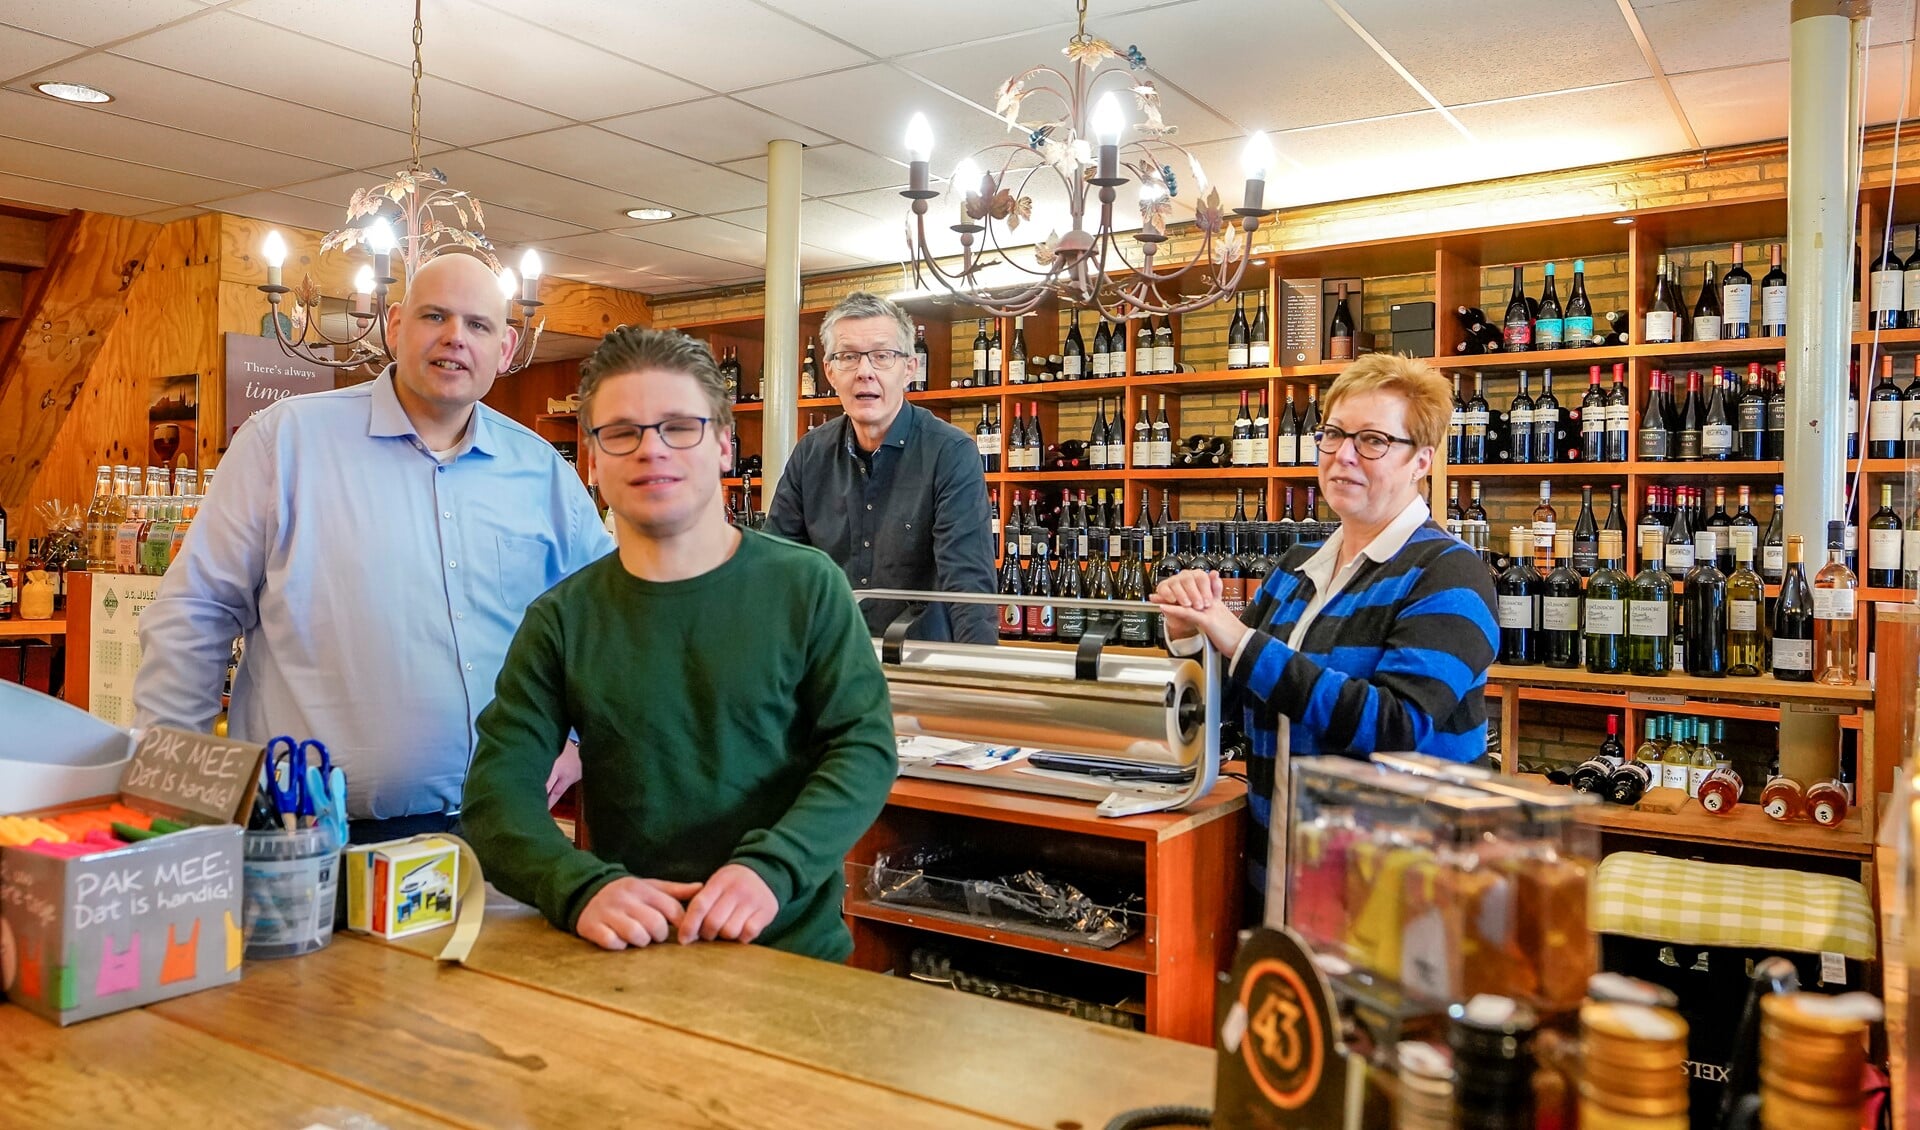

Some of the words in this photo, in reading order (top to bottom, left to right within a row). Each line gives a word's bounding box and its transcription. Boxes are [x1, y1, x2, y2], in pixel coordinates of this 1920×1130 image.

[244, 361, 282, 375] There's
[284, 367, 316, 380] always
[140, 727, 186, 764] PAK
[127, 758, 161, 789] Dat
[161, 769, 177, 793] is
[75, 869, 143, 903] PAK
[73, 900, 122, 930] Dat
[130, 891, 150, 915] is
[1251, 993, 1301, 1071] 43
